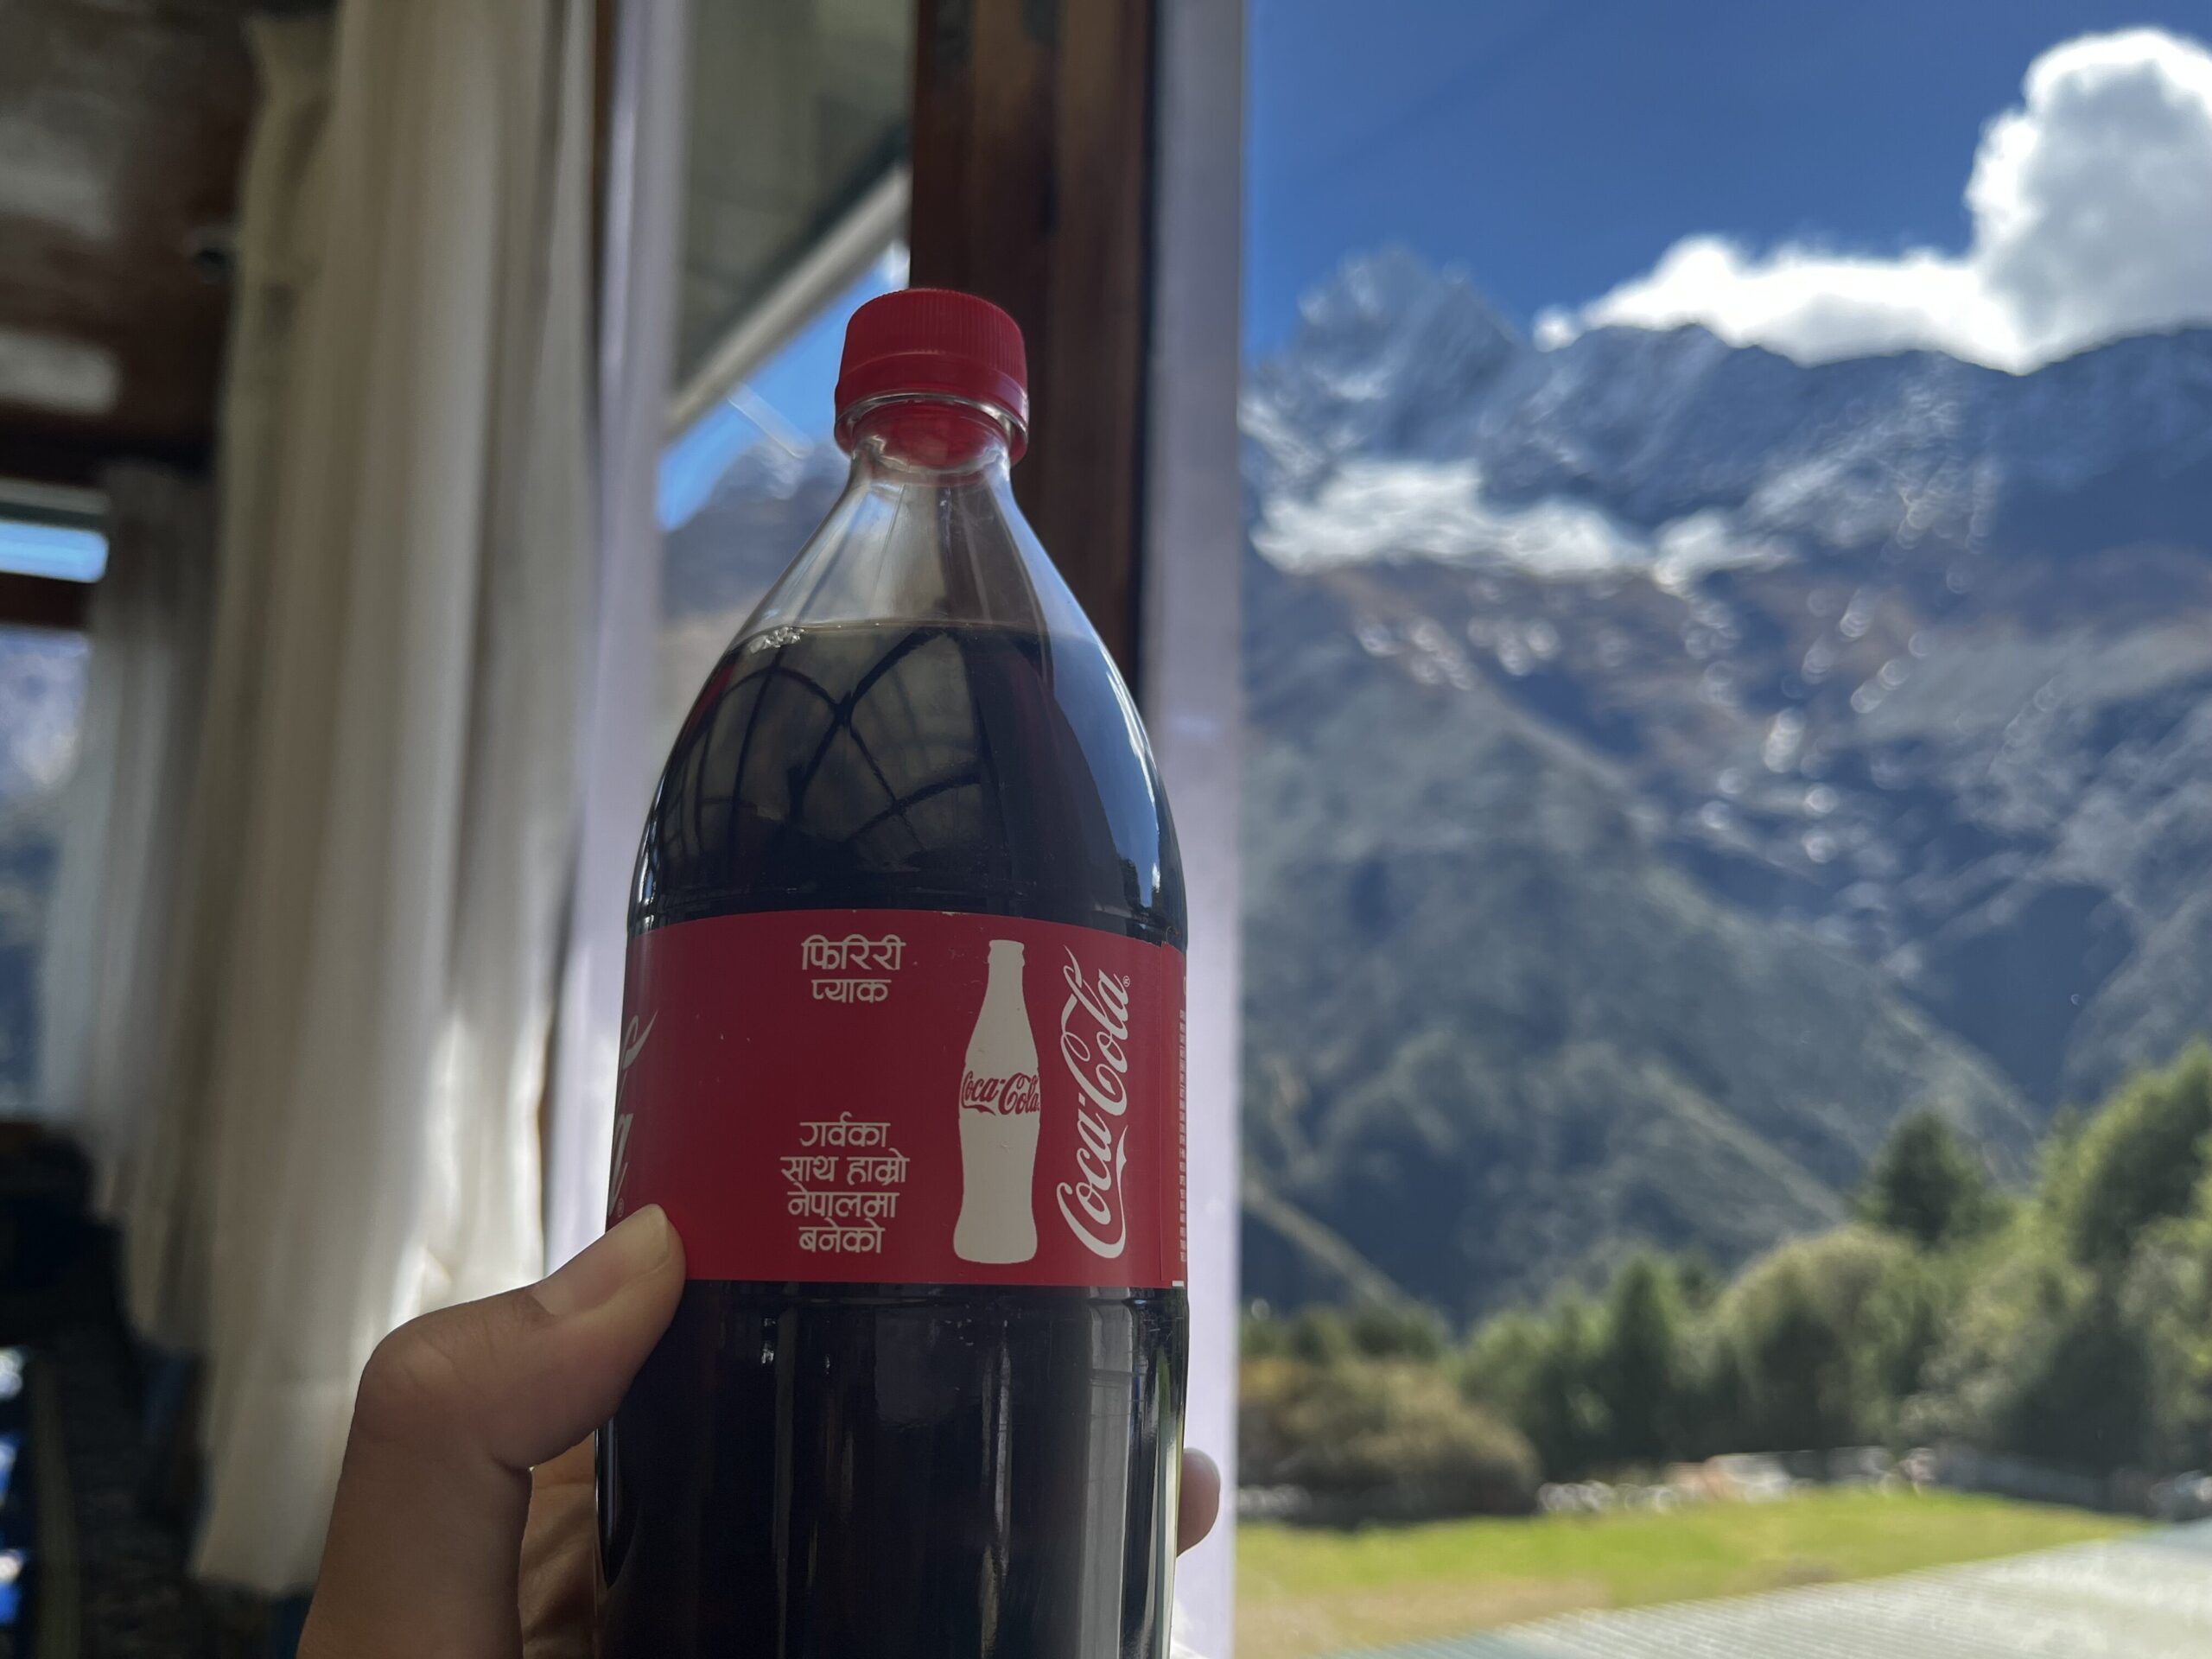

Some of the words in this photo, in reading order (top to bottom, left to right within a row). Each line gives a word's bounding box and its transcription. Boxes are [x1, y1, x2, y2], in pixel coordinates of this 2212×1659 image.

[810, 979, 892, 1003] प्याक
[962, 1071, 1040, 1116] Coca-Cola
[1056, 944, 1129, 1259] Coca-Cola
[799, 1111, 891, 1147] गर्वका
[779, 1155, 839, 1182] साथ
[846, 1147, 910, 1185] हाम्रो
[787, 1181, 900, 1217] नेपालमा
[798, 1217, 886, 1253] बनेको
